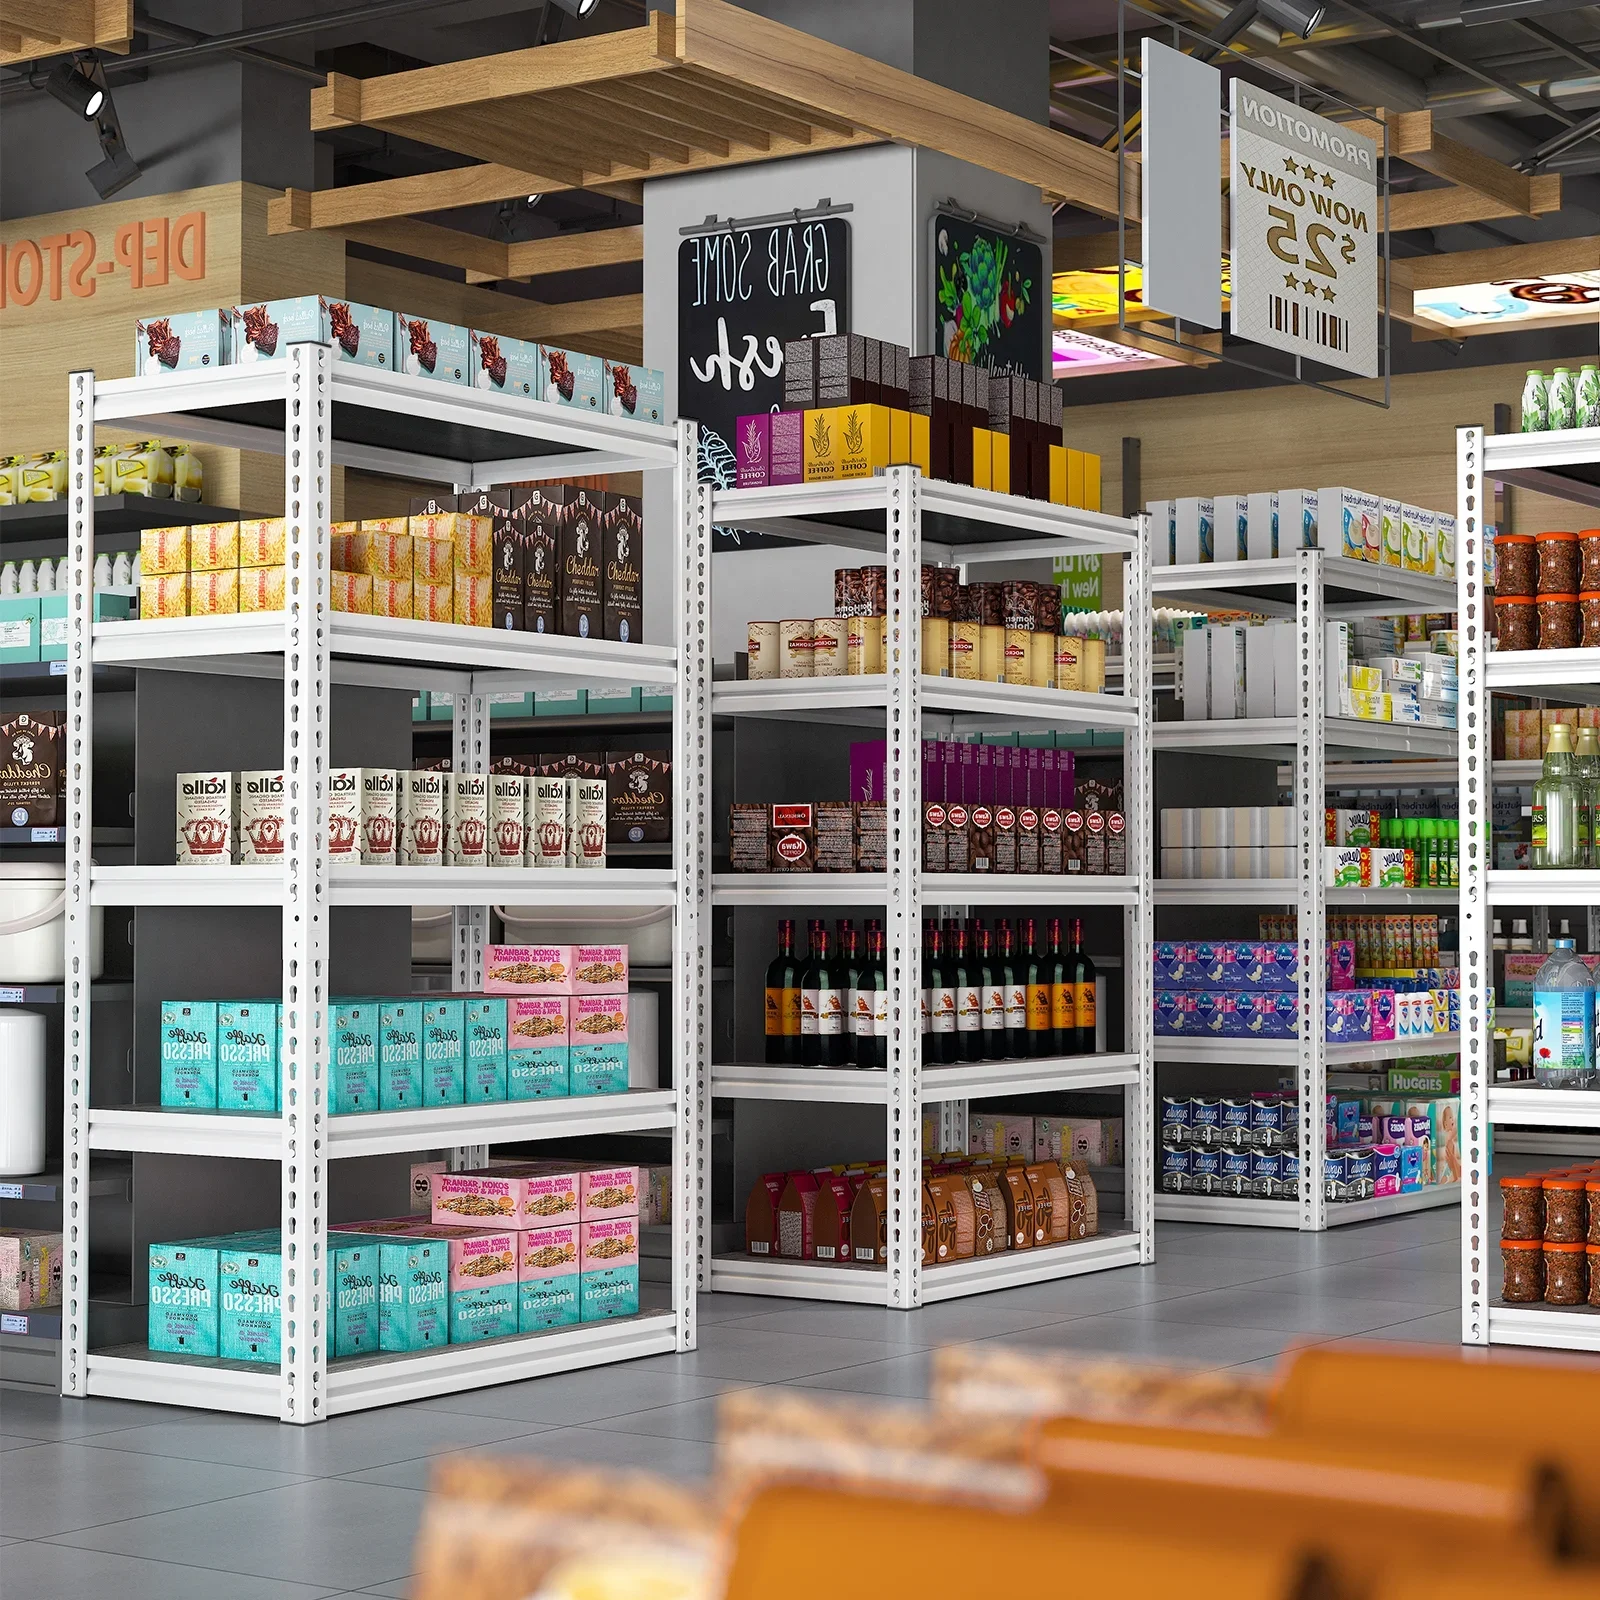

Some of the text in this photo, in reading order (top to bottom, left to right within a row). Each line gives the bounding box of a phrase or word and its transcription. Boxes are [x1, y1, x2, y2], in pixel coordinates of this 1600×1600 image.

[566, 554, 600, 577] Cheddar
[607, 561, 640, 583] Cheddar
[496, 568, 522, 585] Cheddar
[527, 572, 553, 589] Cheddar
[604, 948, 621, 956] KOKOS
[1393, 1074, 1442, 1091] HUGGIES
[1166, 1106, 1188, 1121] always
[1195, 1107, 1217, 1123] always
[1225, 1108, 1248, 1124] always
[1255, 1109, 1278, 1126] always
[1166, 1154, 1188, 1170] always
[1195, 1155, 1217, 1171] always
[1225, 1156, 1248, 1173] always
[1255, 1158, 1278, 1174] always
[1351, 1160, 1372, 1176] always
[1379, 1157, 1398, 1173] always
[482, 1181, 509, 1189] KOKOS
[554, 1178, 573, 1188] KOKOS
[491, 1238, 510, 1247] KOKOS
